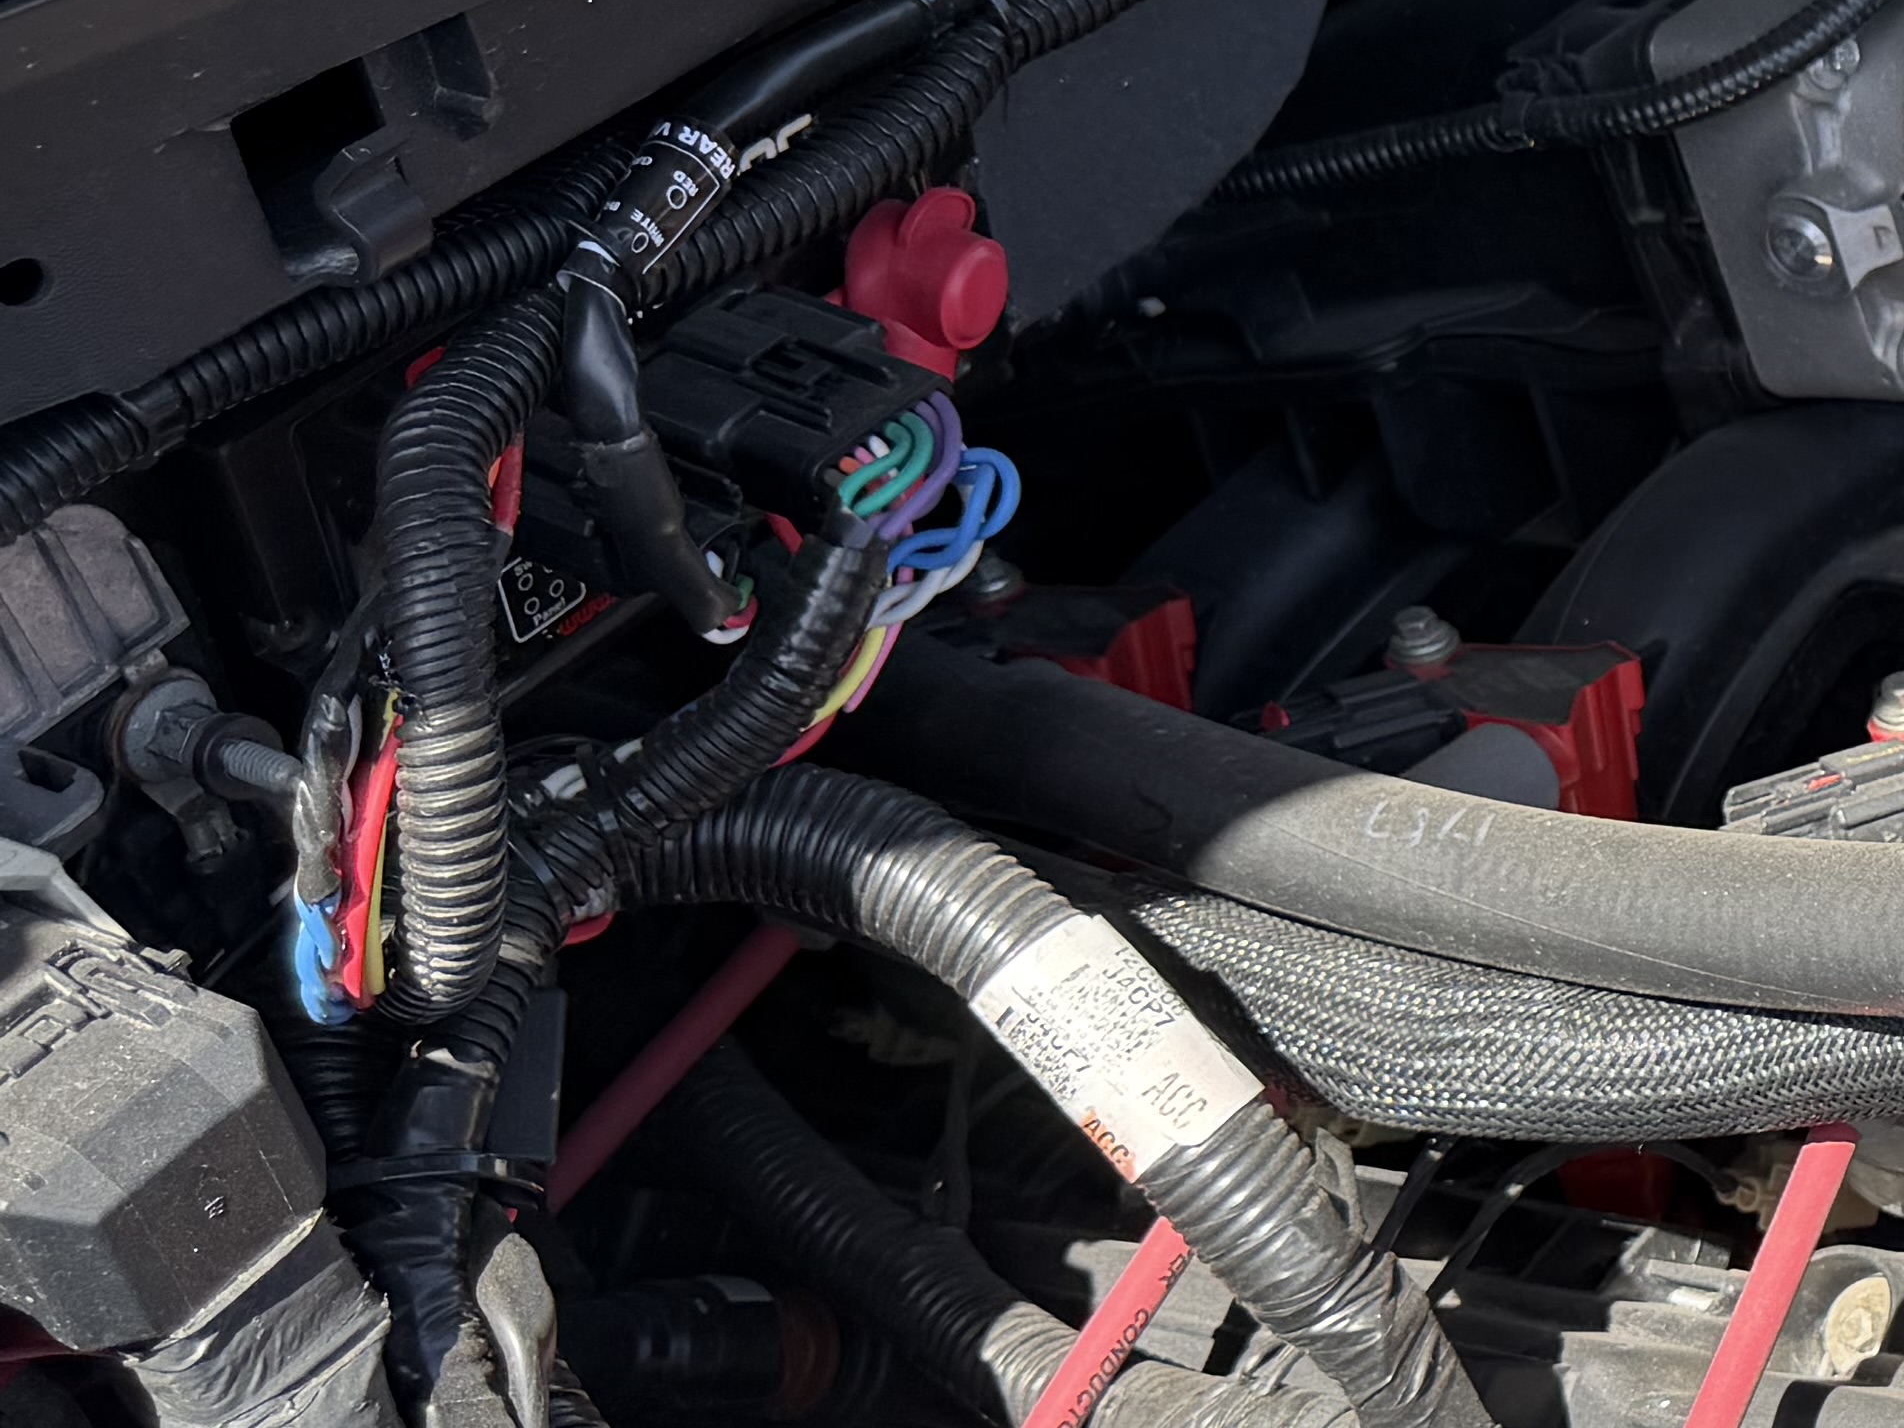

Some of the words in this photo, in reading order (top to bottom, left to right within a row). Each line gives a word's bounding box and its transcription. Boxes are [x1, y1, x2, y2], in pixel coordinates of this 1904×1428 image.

[678, 126, 736, 180] REAR
[673, 171, 699, 198] RED
[630, 208, 666, 248] WHITE
[1103, 968, 1176, 1028] J4CP7
[1141, 1072, 1208, 1130] ACC
[1083, 1118, 1130, 1164] ACC
